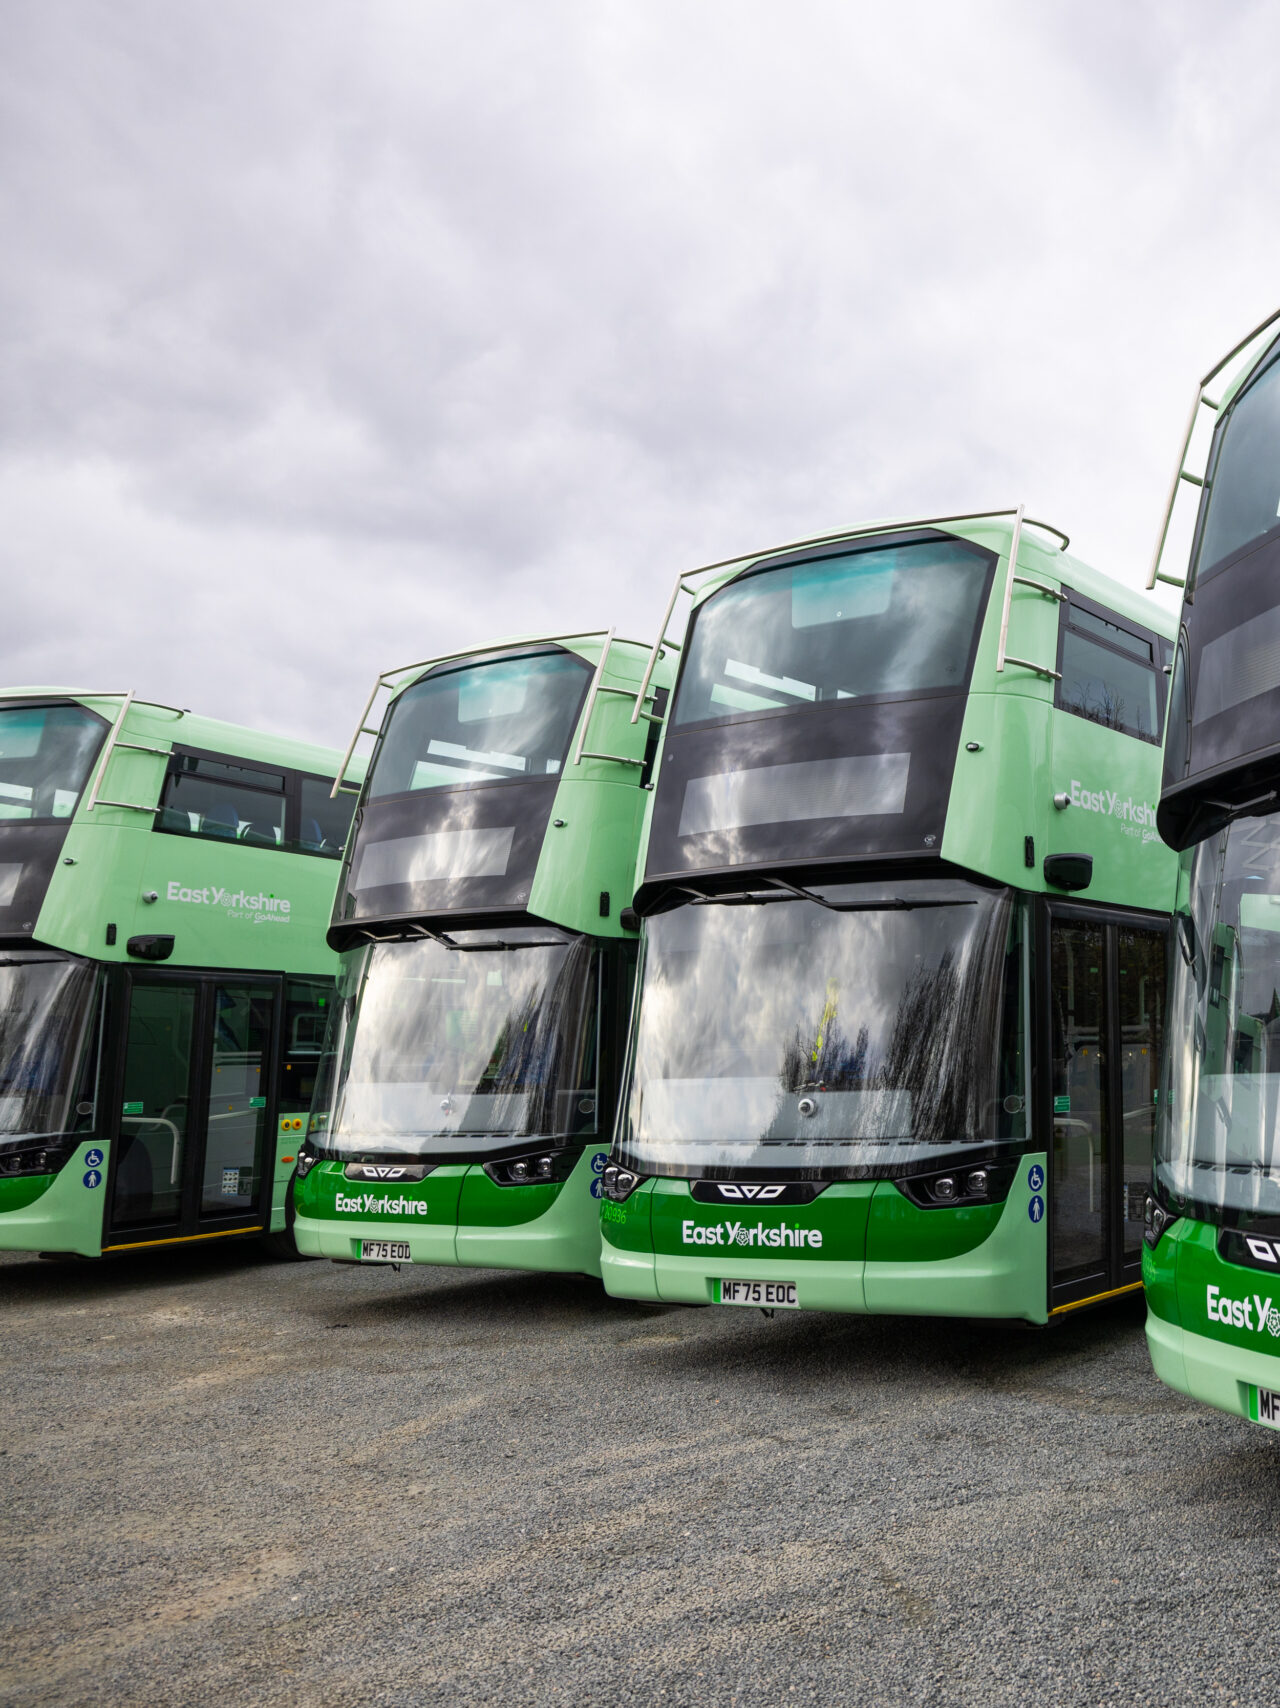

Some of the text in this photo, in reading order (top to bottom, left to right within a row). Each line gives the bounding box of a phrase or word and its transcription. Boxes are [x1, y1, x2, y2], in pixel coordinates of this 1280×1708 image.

[1070, 779, 1157, 828] East Yorkshi
[166, 880, 291, 913] East Yorkshire
[227, 909, 243, 918] Part
[335, 1193, 428, 1216] East Yorkshire
[682, 1220, 823, 1249] East Yorkshire
[362, 1241, 411, 1260] MF75 EOD
[722, 1281, 797, 1304] MF75 EOC
[1206, 1284, 1254, 1331] East
